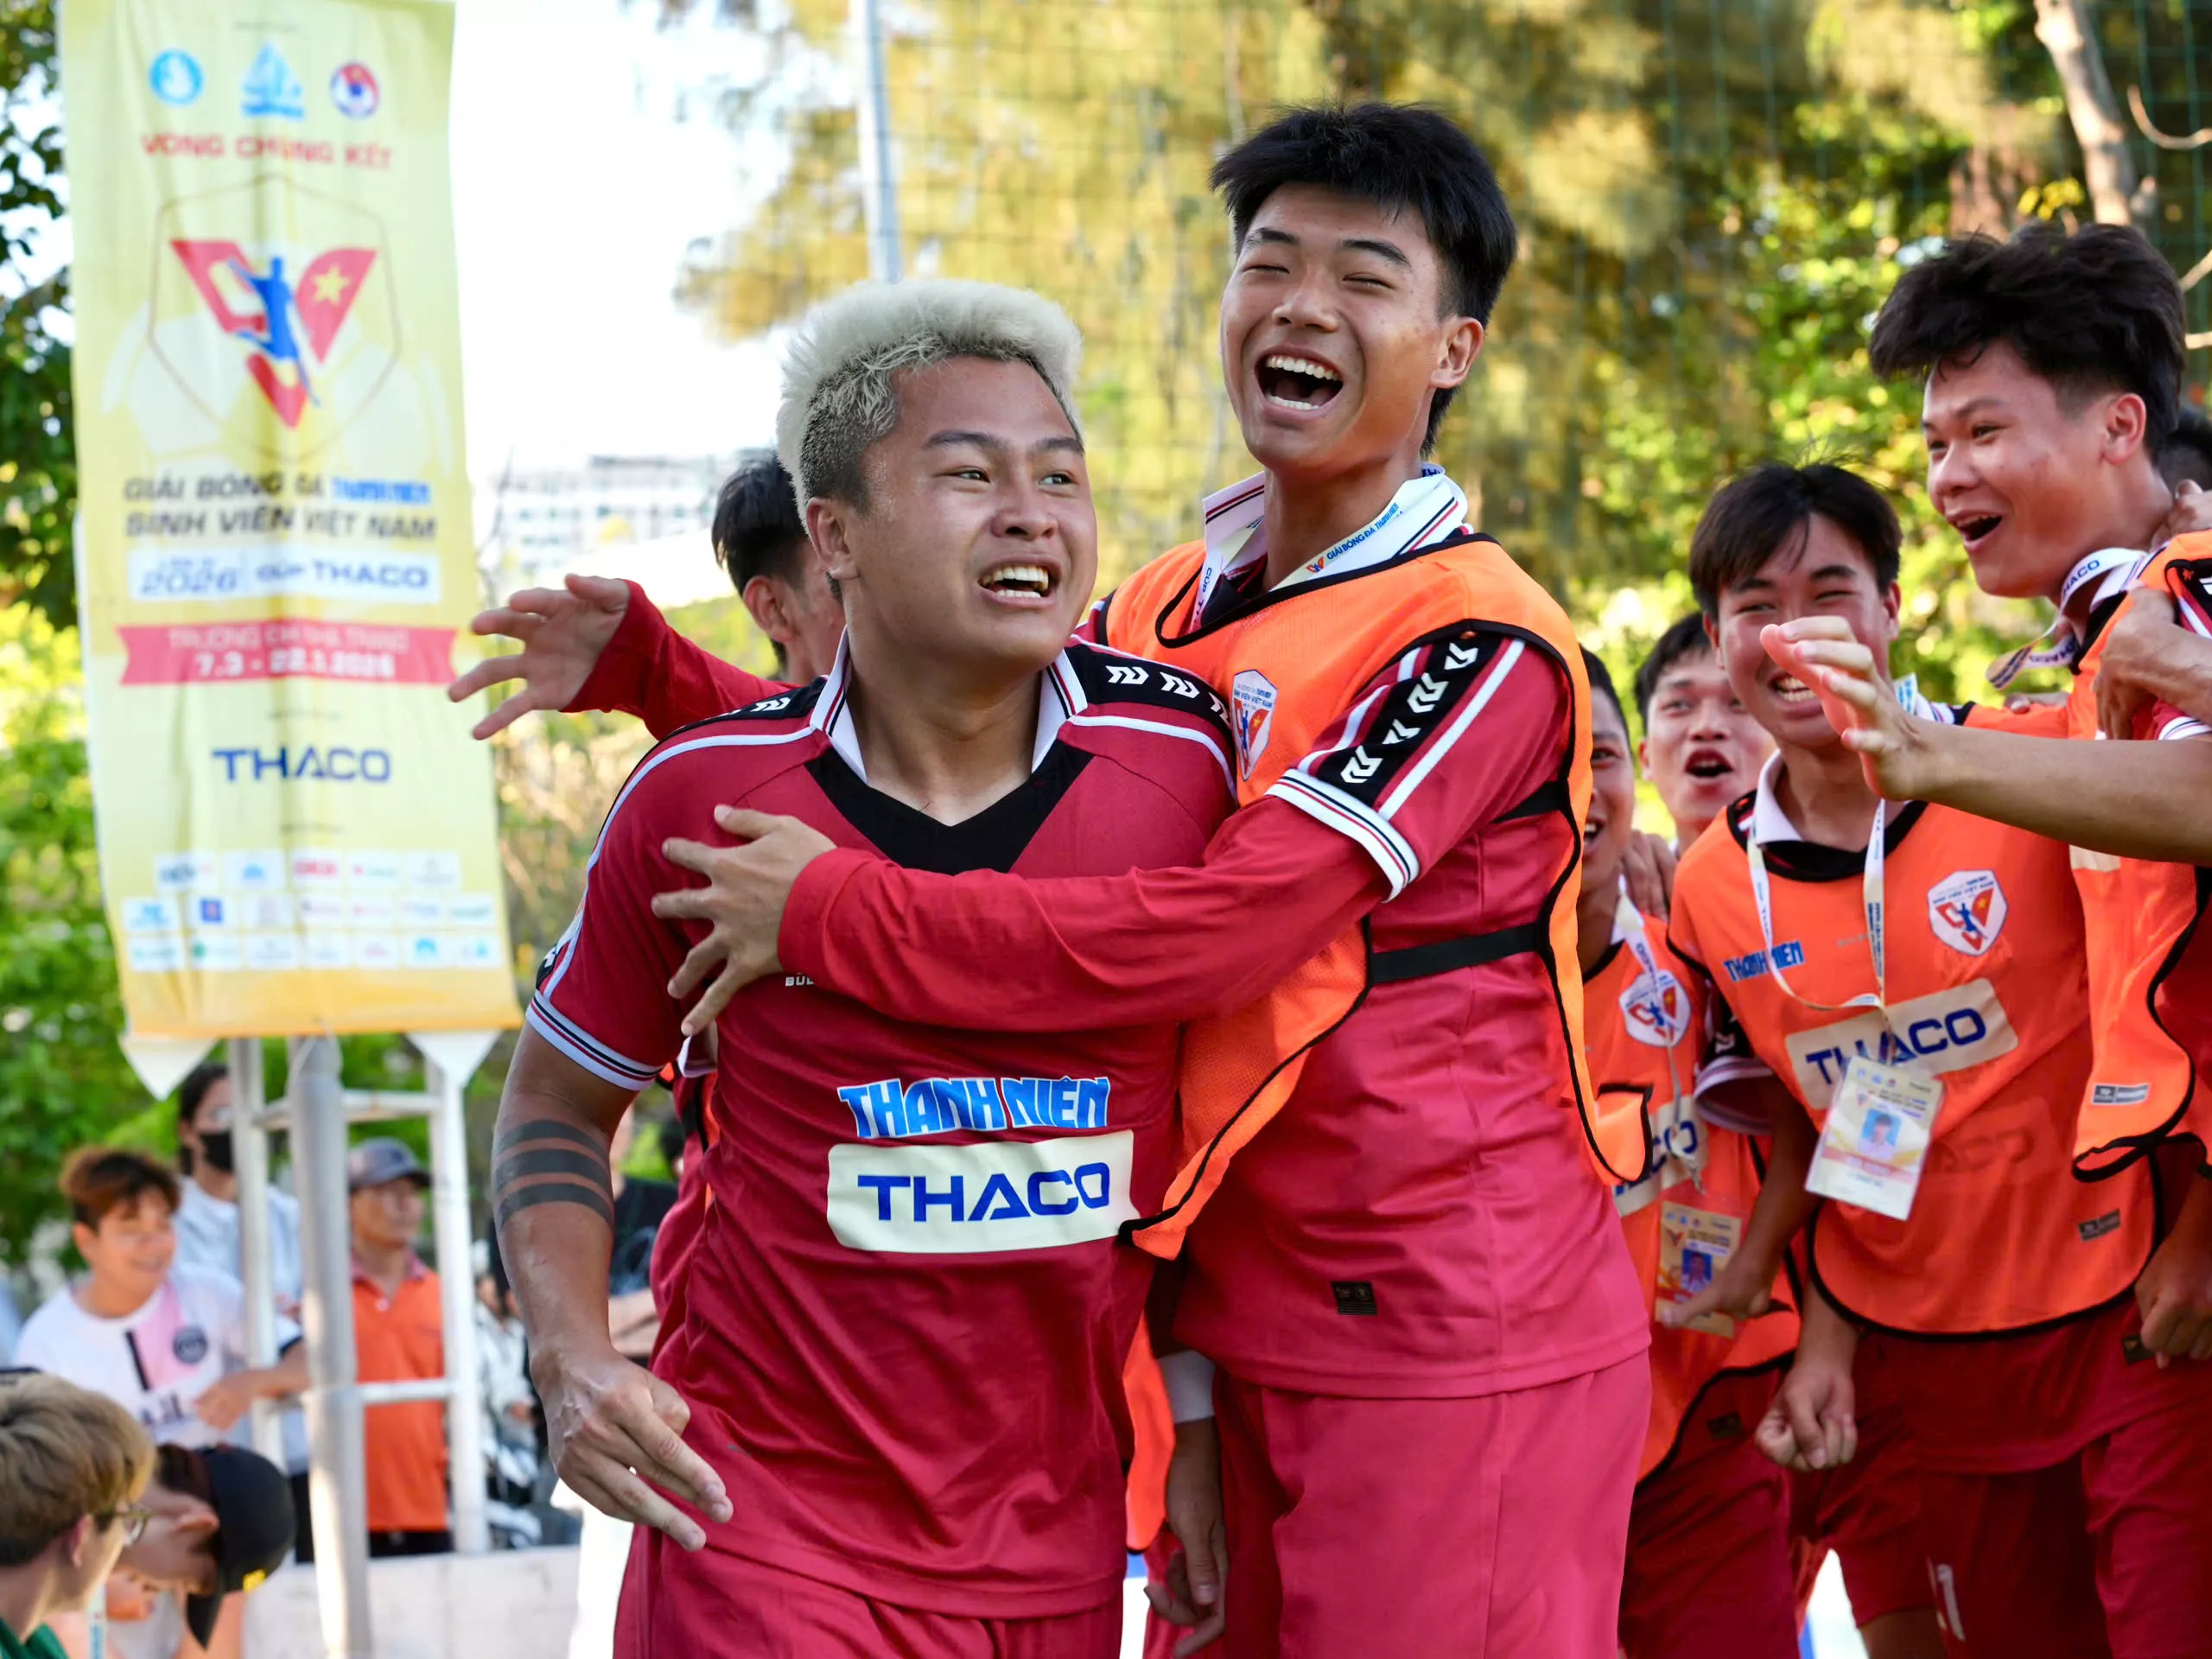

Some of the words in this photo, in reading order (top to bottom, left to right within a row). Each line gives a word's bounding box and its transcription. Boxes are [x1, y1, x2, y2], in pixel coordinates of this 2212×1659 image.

[313, 557, 430, 589] THACO
[212, 746, 391, 783] THACO
[857, 1161, 1110, 1223] THACO
